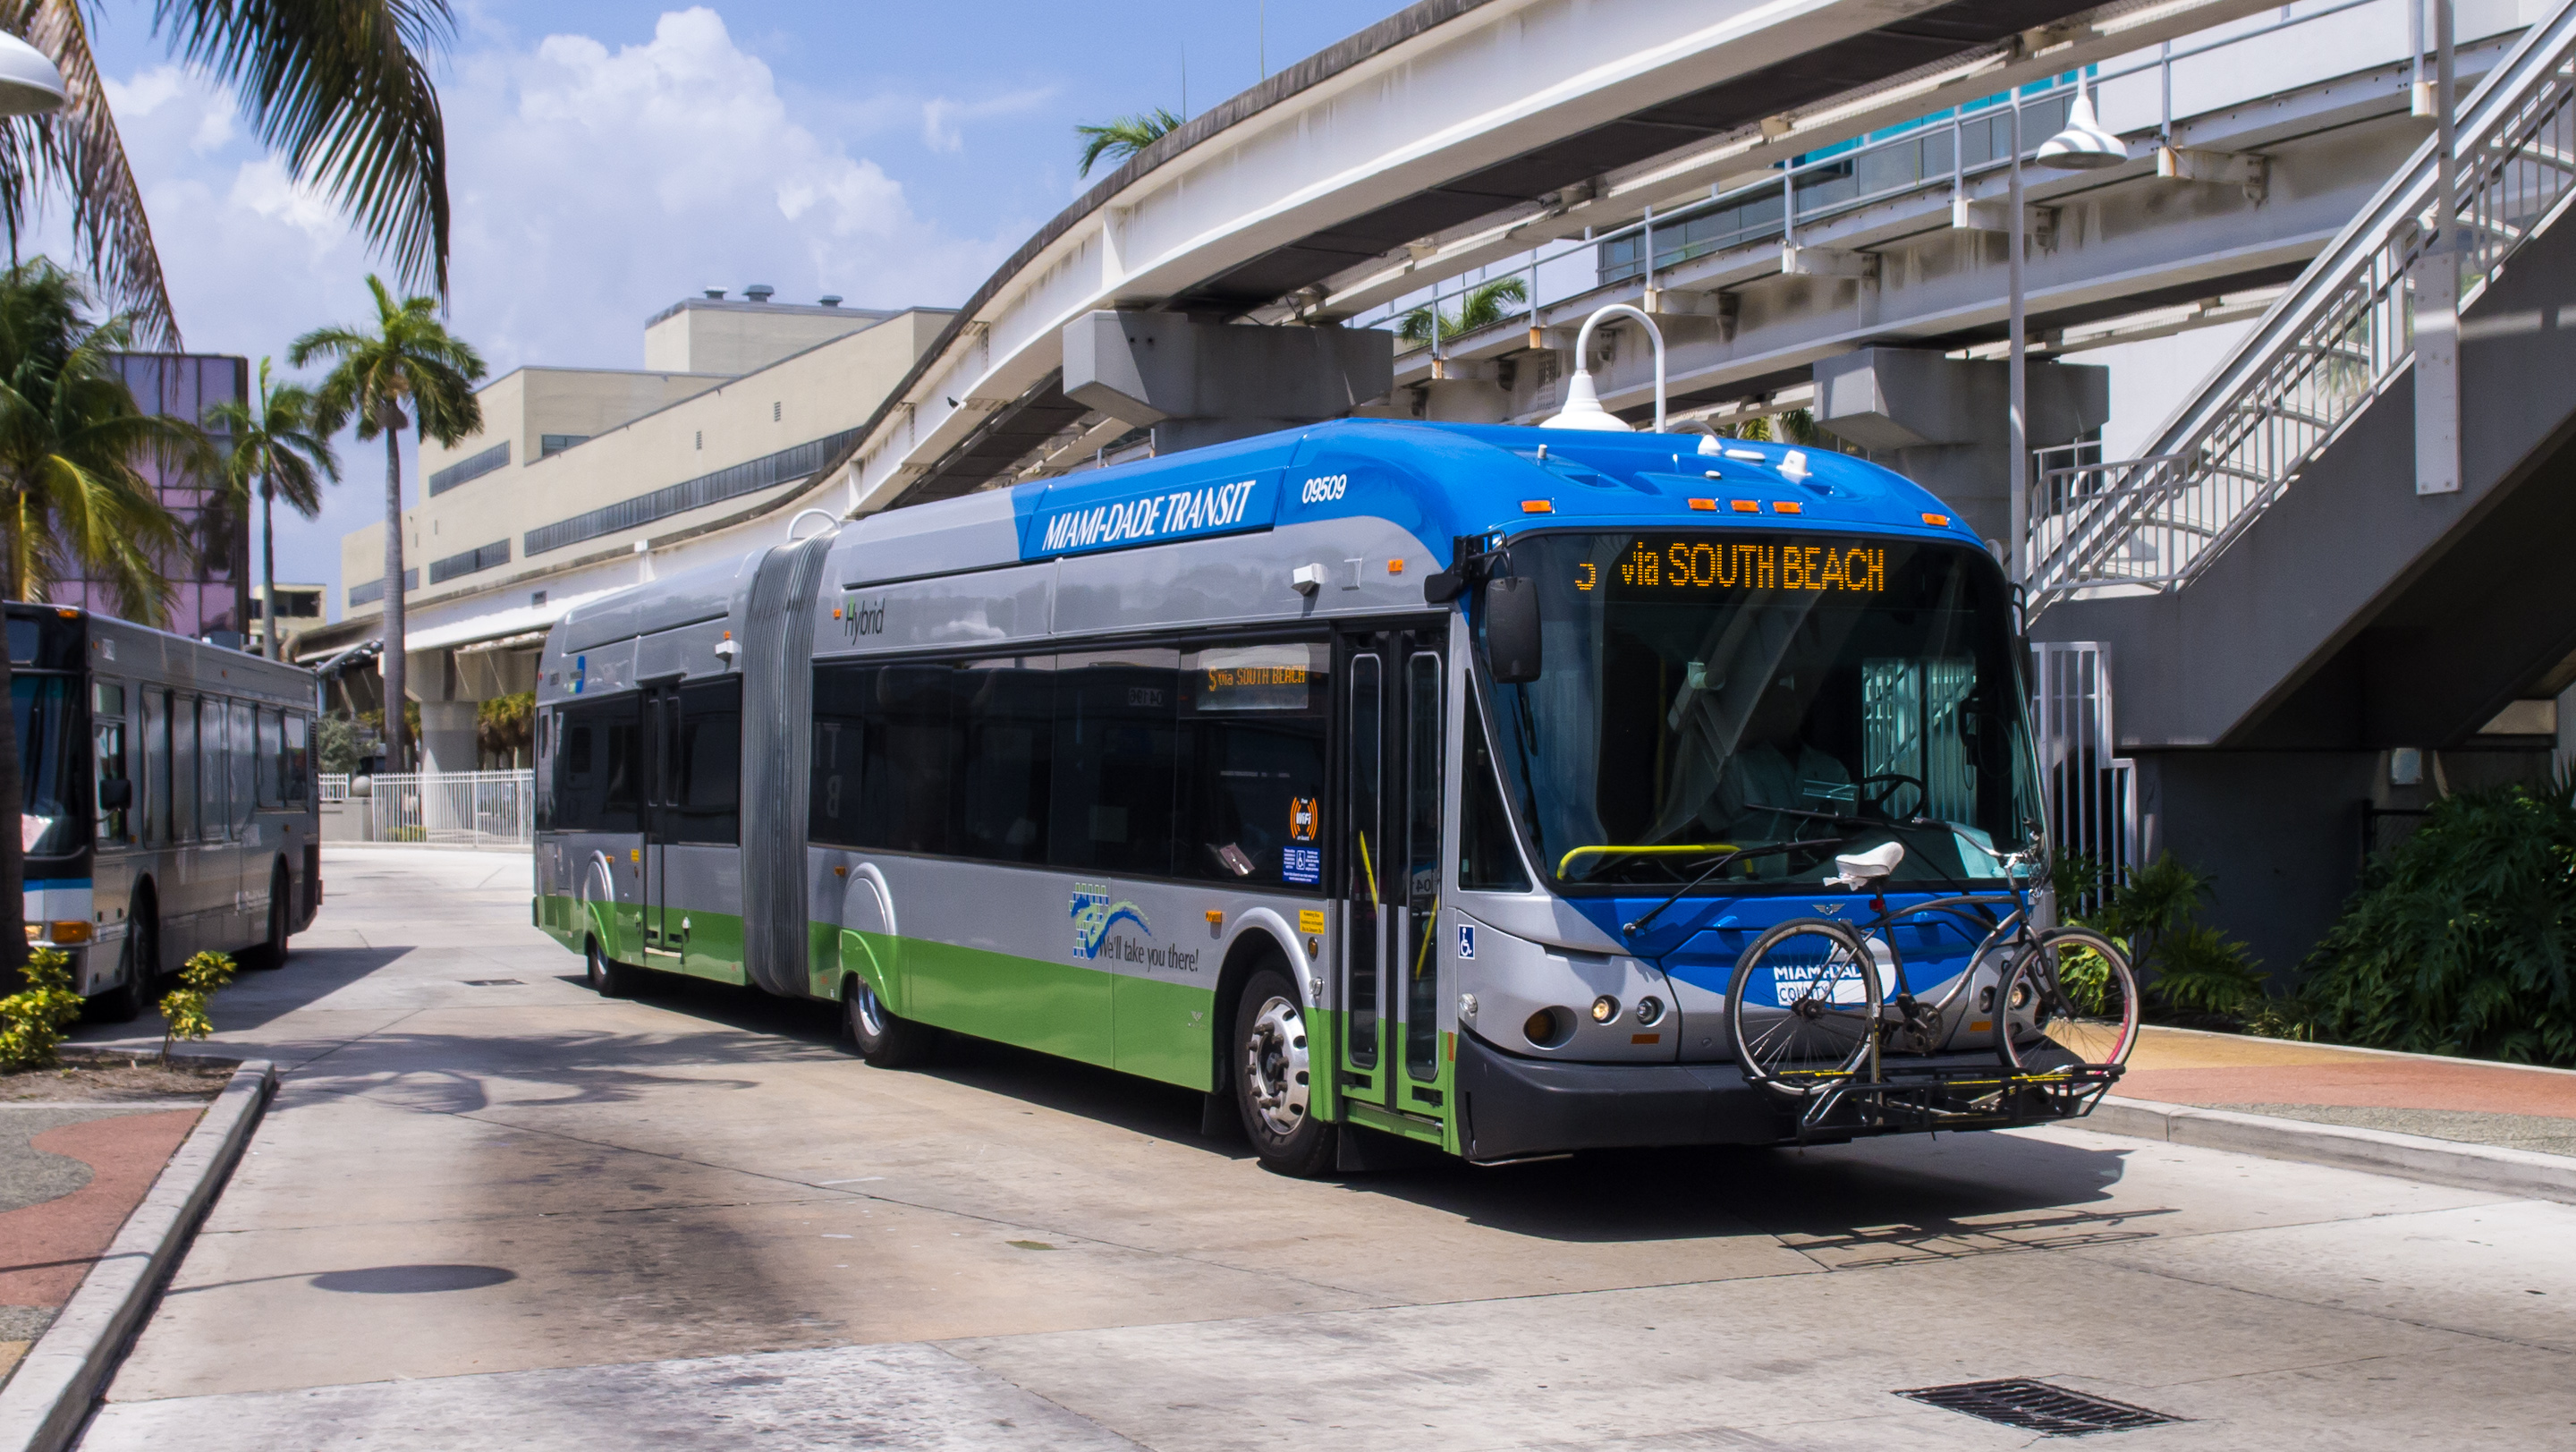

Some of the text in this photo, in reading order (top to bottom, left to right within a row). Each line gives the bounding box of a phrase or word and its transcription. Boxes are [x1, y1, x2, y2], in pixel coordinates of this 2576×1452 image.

[1302, 474, 1347, 505] 09509
[1042, 480, 1257, 551] MIAMI-DADE TRANSIT
[1622, 542, 1659, 586] via
[1668, 543, 1774, 589] SOUTH
[1783, 546, 1885, 591] BEACH
[844, 598, 886, 646] Hybrid
[1236, 667, 1269, 685] SOUTH
[1272, 666, 1306, 684] BEACH
[1296, 811, 1311, 825] WiFi
[1098, 935, 1199, 972] We'll take you there!
